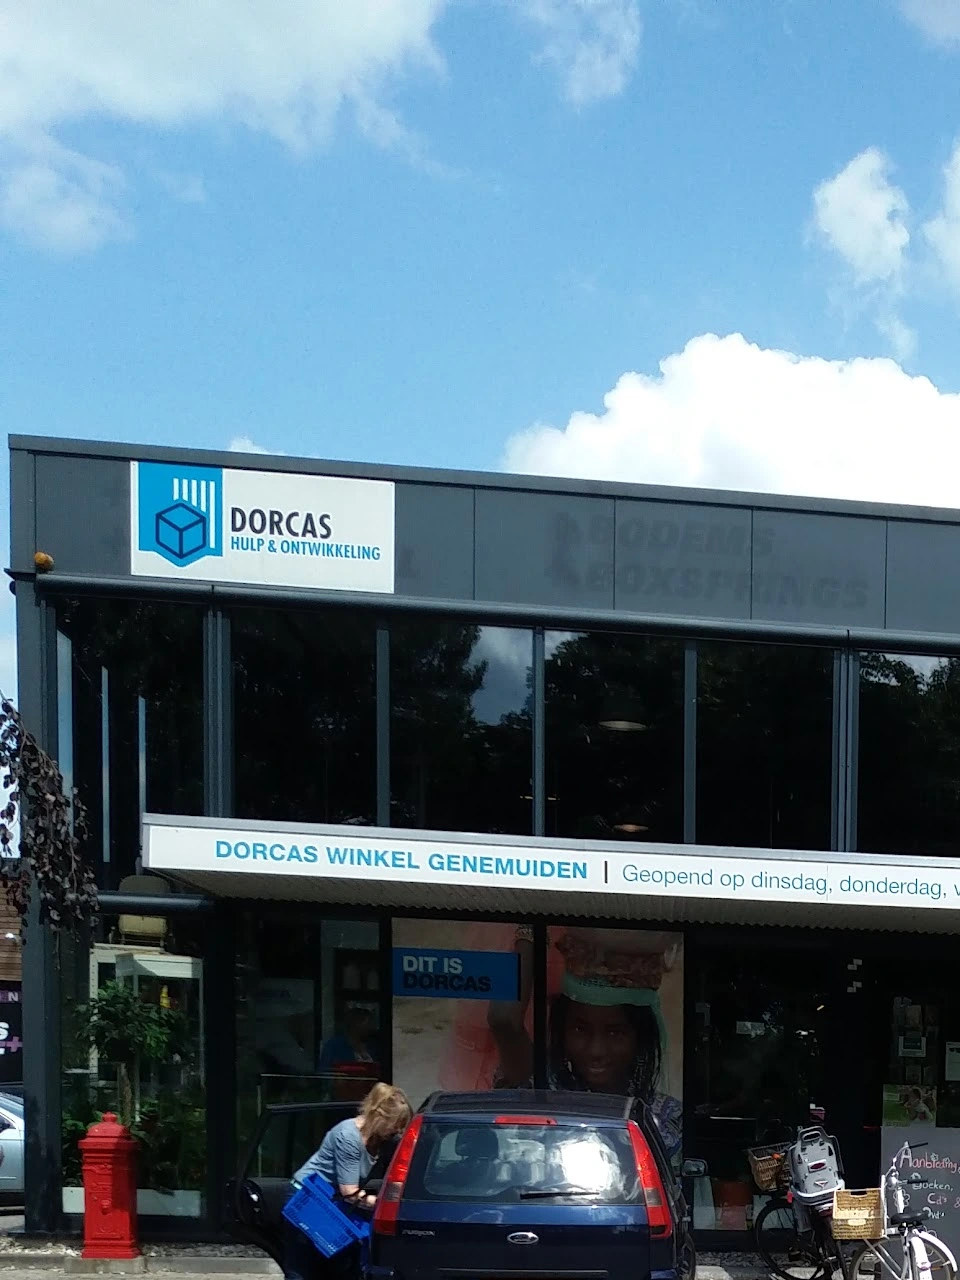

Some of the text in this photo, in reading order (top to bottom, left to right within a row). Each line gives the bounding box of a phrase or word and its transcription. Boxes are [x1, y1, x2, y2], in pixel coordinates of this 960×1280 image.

[231, 507, 332, 539] DORCAS
[231, 536, 381, 560] HULP & ONTWIKKELING
[585, 562, 869, 609] BOXSPRINGS
[215, 840, 318, 863] DORCAS
[327, 847, 420, 870] WINKEL
[428, 853, 588, 879] GENEMUIDEN
[622, 864, 713, 889] Geopend
[720, 873, 745, 889] op
[751, 871, 833, 895] dinsdag,
[840, 875, 947, 900] donderdag,
[403, 955, 463, 974] DIT IS
[403, 973, 491, 992] DORCAS
